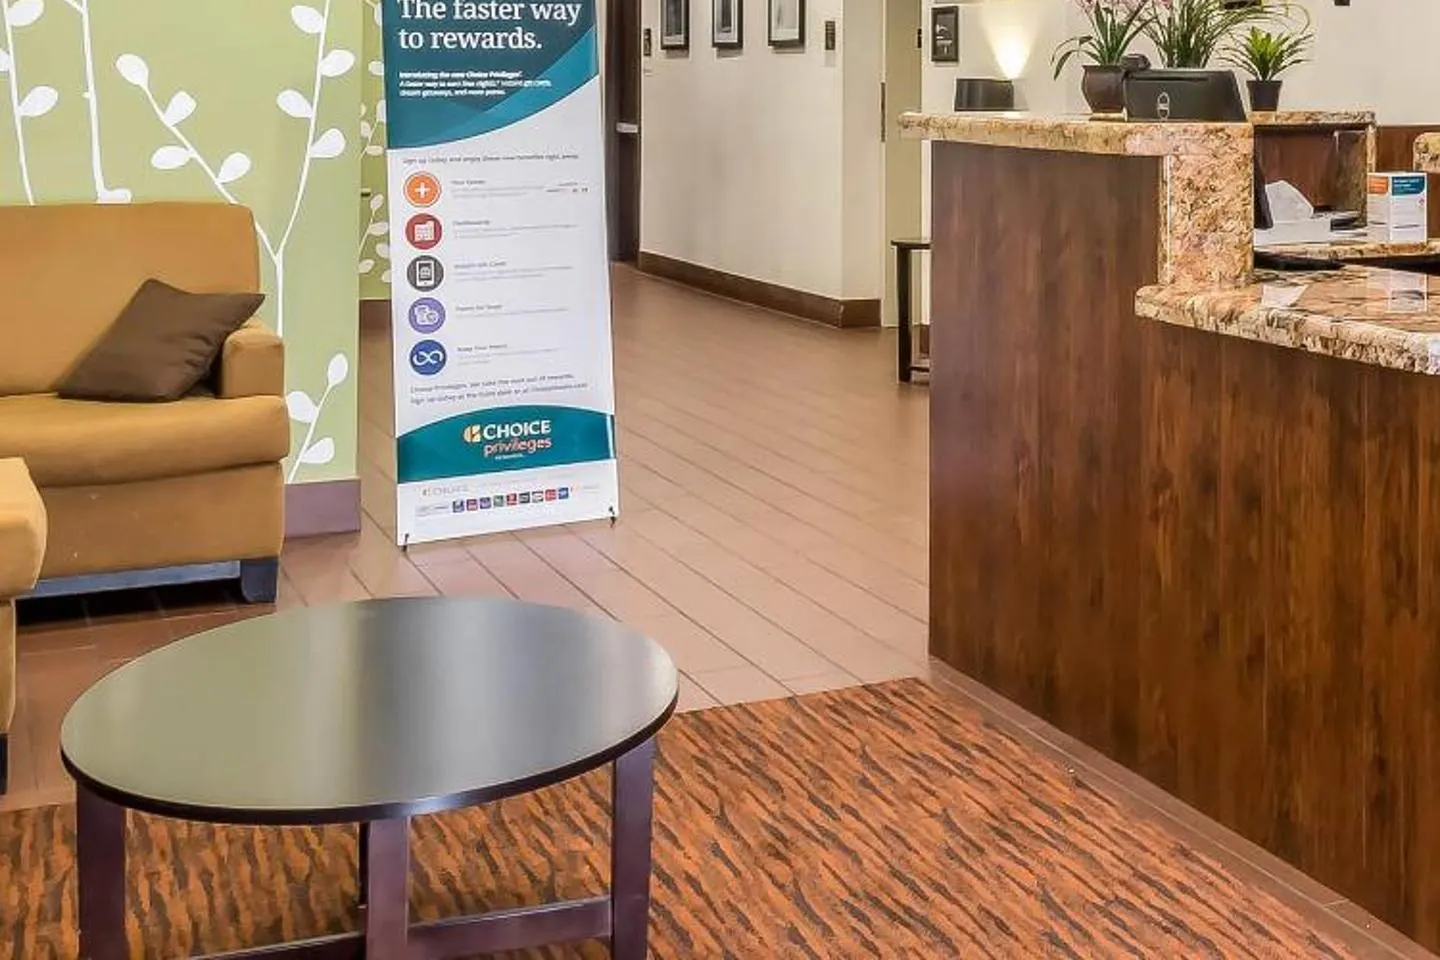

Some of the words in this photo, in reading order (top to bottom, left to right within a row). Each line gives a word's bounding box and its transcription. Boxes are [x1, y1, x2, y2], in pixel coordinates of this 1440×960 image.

[530, 3, 582, 27] way
[399, 26, 424, 50] to
[430, 27, 543, 50] rewards.
[483, 420, 551, 440] CHOICE
[484, 437, 552, 458] privileges
